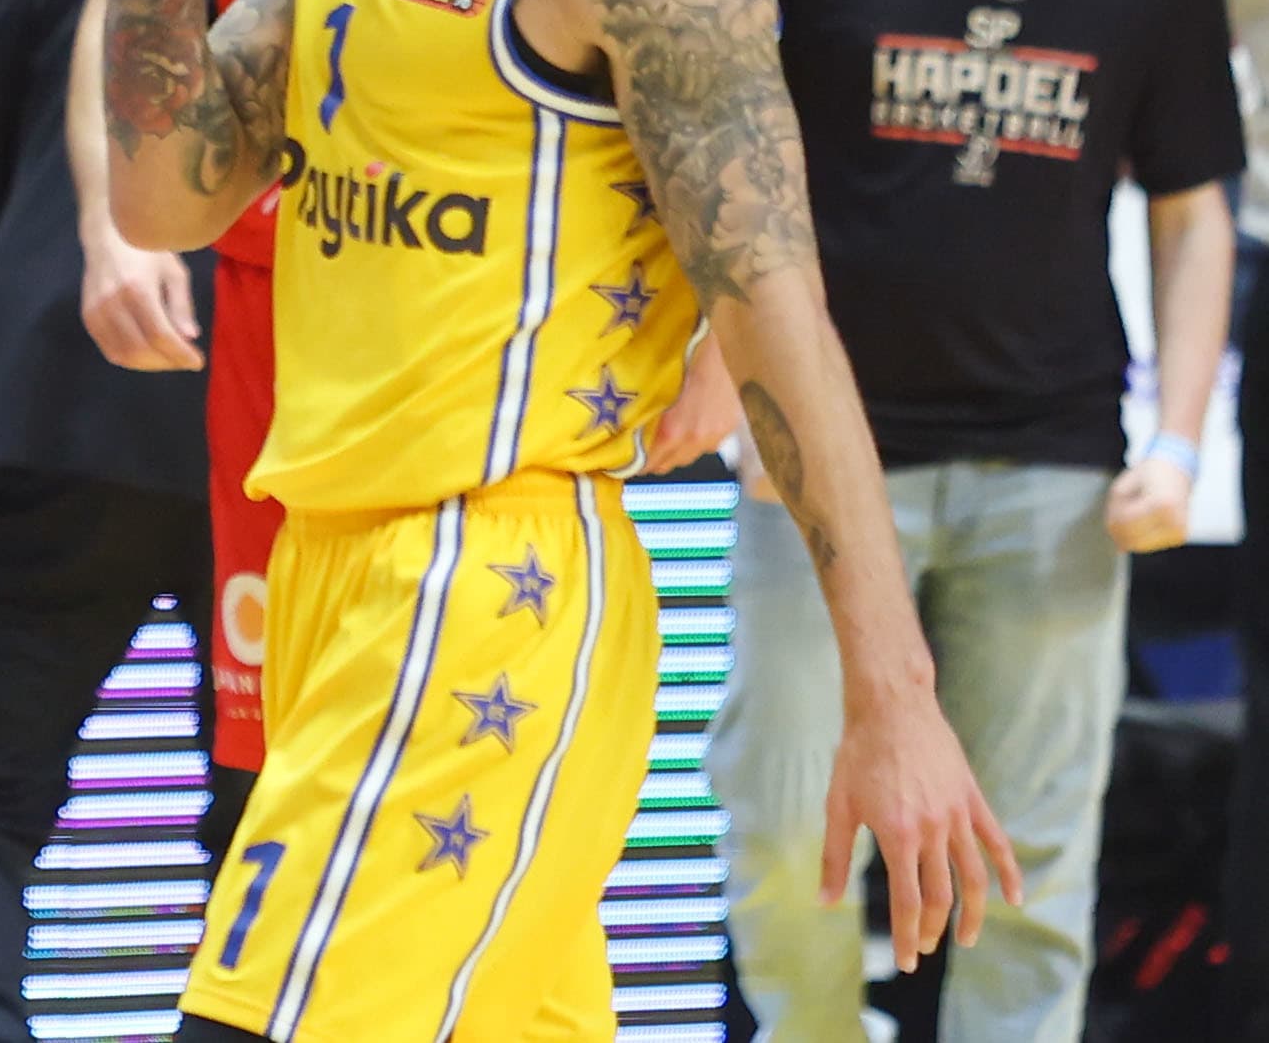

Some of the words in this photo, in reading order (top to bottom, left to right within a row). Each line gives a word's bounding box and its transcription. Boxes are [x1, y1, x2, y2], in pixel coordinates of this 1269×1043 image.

[319, 3, 356, 135] 1
[965, 7, 1022, 48] SP
[873, 45, 1090, 121] HAPOEL
[219, 841, 286, 971] 1
